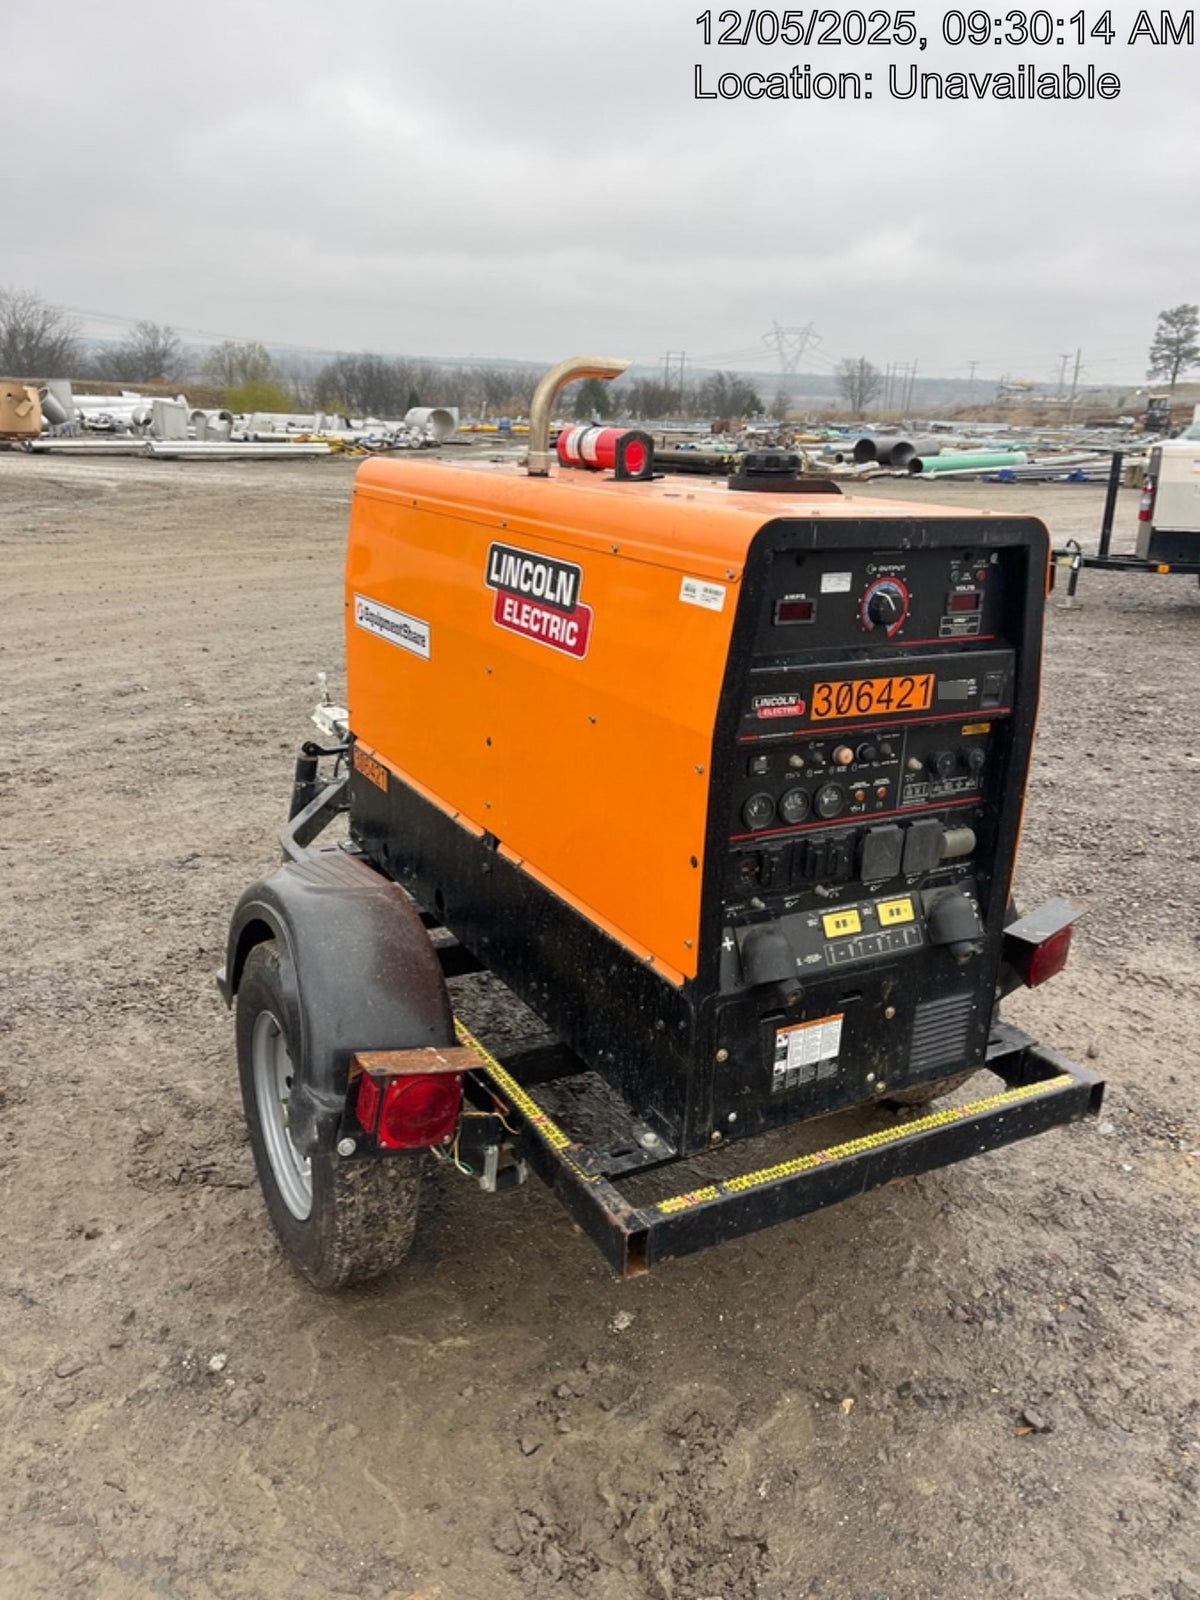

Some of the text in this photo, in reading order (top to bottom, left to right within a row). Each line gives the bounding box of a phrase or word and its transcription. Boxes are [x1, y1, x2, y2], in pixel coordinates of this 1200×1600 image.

[489, 549, 576, 607] LINCOLN
[502, 597, 579, 647] ELECTRIC
[755, 696, 798, 708] LINCOLN
[814, 674, 932, 718] 306421
